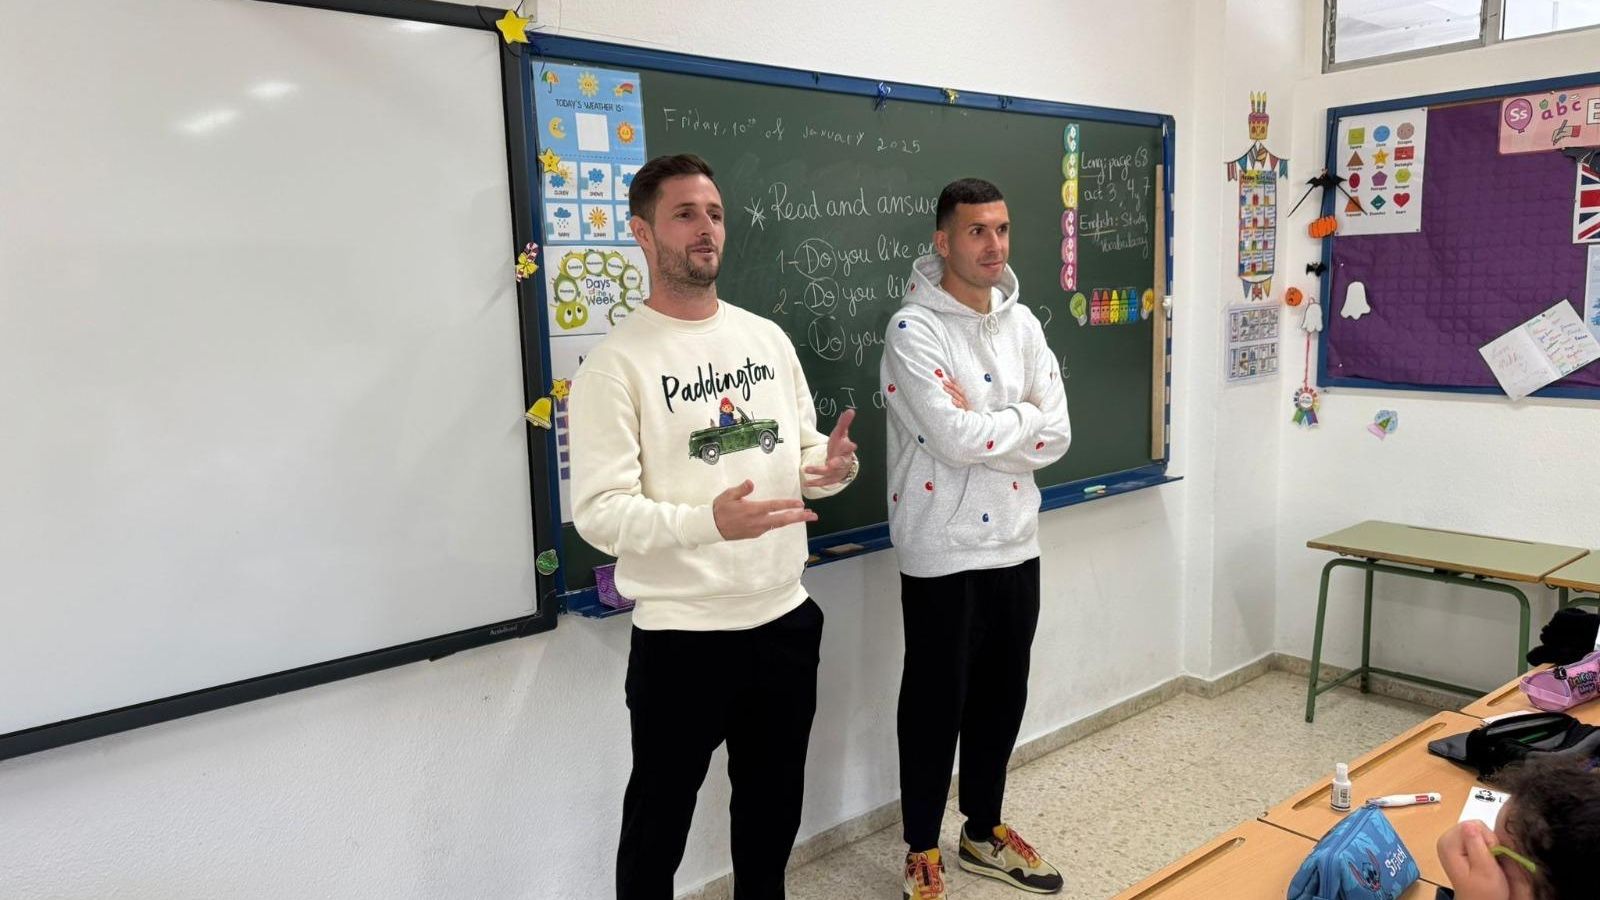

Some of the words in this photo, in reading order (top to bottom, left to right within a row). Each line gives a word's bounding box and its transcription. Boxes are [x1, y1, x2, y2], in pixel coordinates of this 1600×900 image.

[555, 99, 581, 108] TODAY'S
[583, 101, 613, 111] WEATHER
[616, 104, 624, 112] IS:
[1510, 108, 1528, 121] Ss
[765, 118, 784, 141] of
[877, 138, 921, 153] 2025
[1108, 154, 1132, 180] page
[1134, 145, 1148, 167] 68
[769, 182, 822, 221] Read
[826, 187, 871, 218] and
[877, 194, 938, 217] answe
[1084, 187, 1104, 200] act
[1144, 177, 1151, 196] 7
[802, 243, 833, 274] Do
[837, 249, 873, 277] you
[878, 234, 912, 261] like
[585, 279, 610, 290] Days
[585, 293, 616, 306] Week
[808, 281, 836, 308] Do
[842, 288, 877, 317] you
[811, 320, 842, 353] Do
[851, 330, 886, 367] you
[662, 357, 775, 413] Paddington
[840, 387, 859, 410] I
